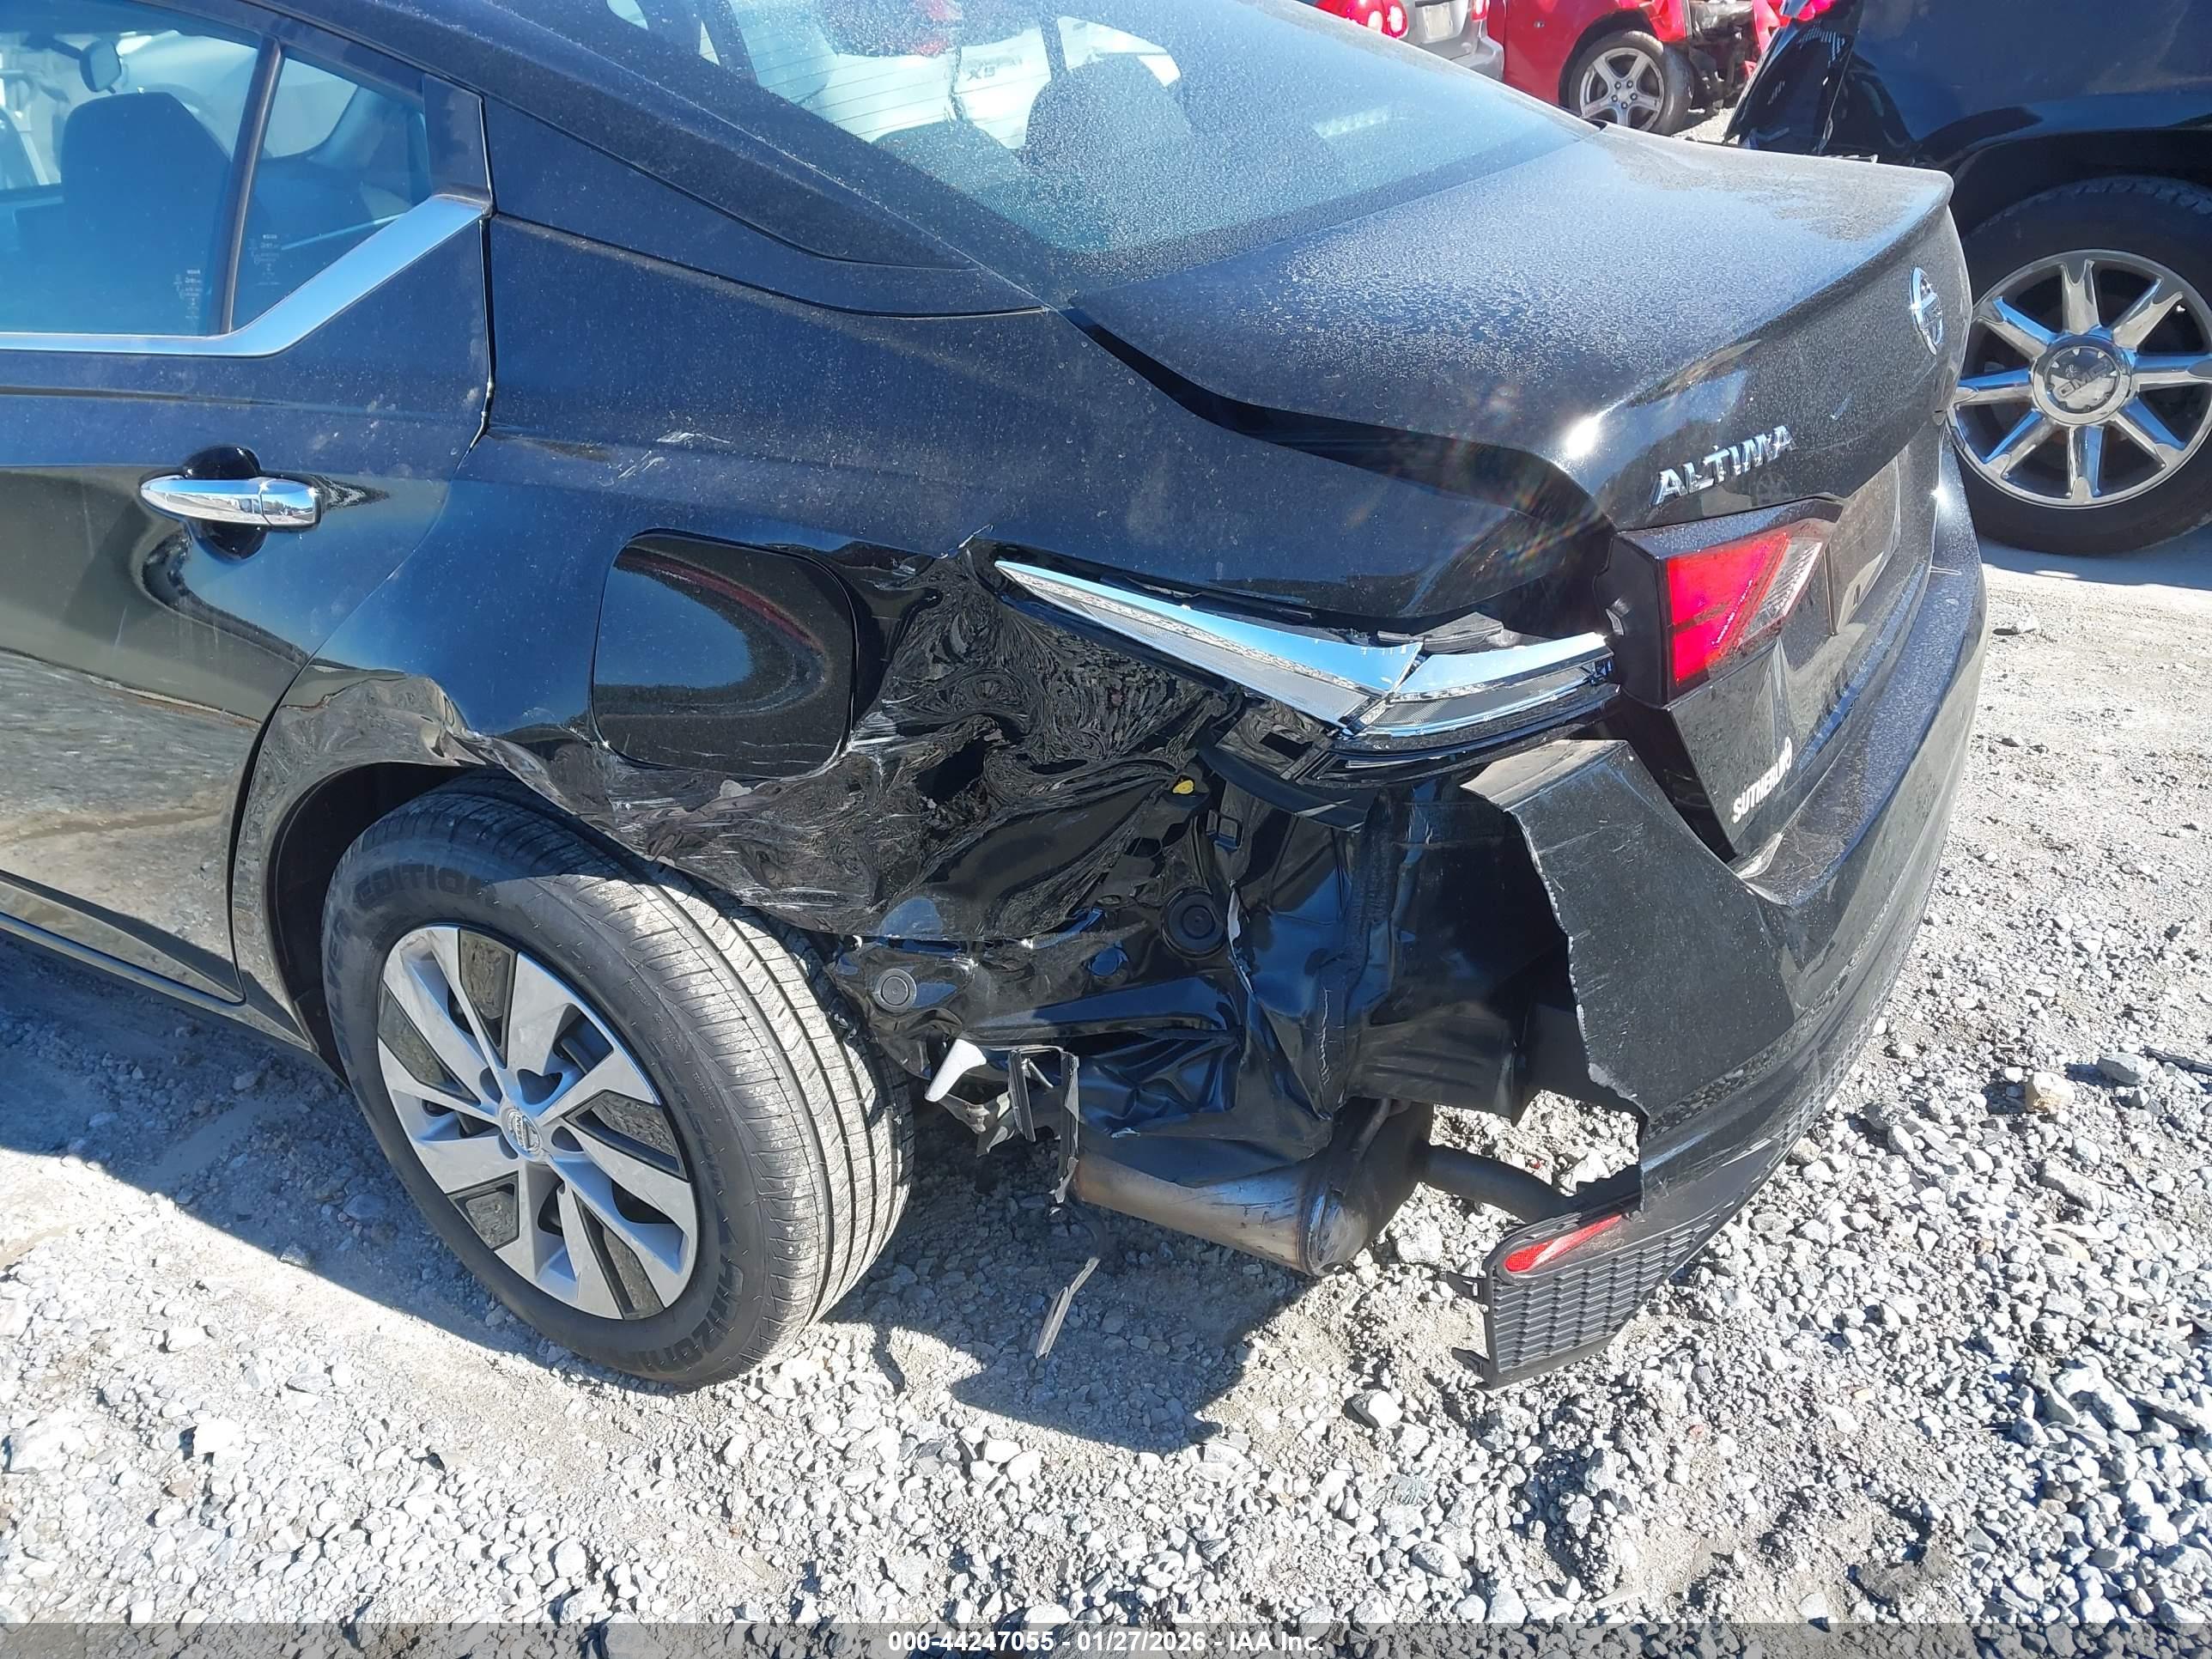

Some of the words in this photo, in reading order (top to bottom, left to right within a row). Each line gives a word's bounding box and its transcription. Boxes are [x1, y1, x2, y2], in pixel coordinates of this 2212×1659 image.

[2057, 362, 2109, 398] GMC
[1650, 425, 1794, 505] ALTIMA
[353, 863, 497, 911] EDITION
